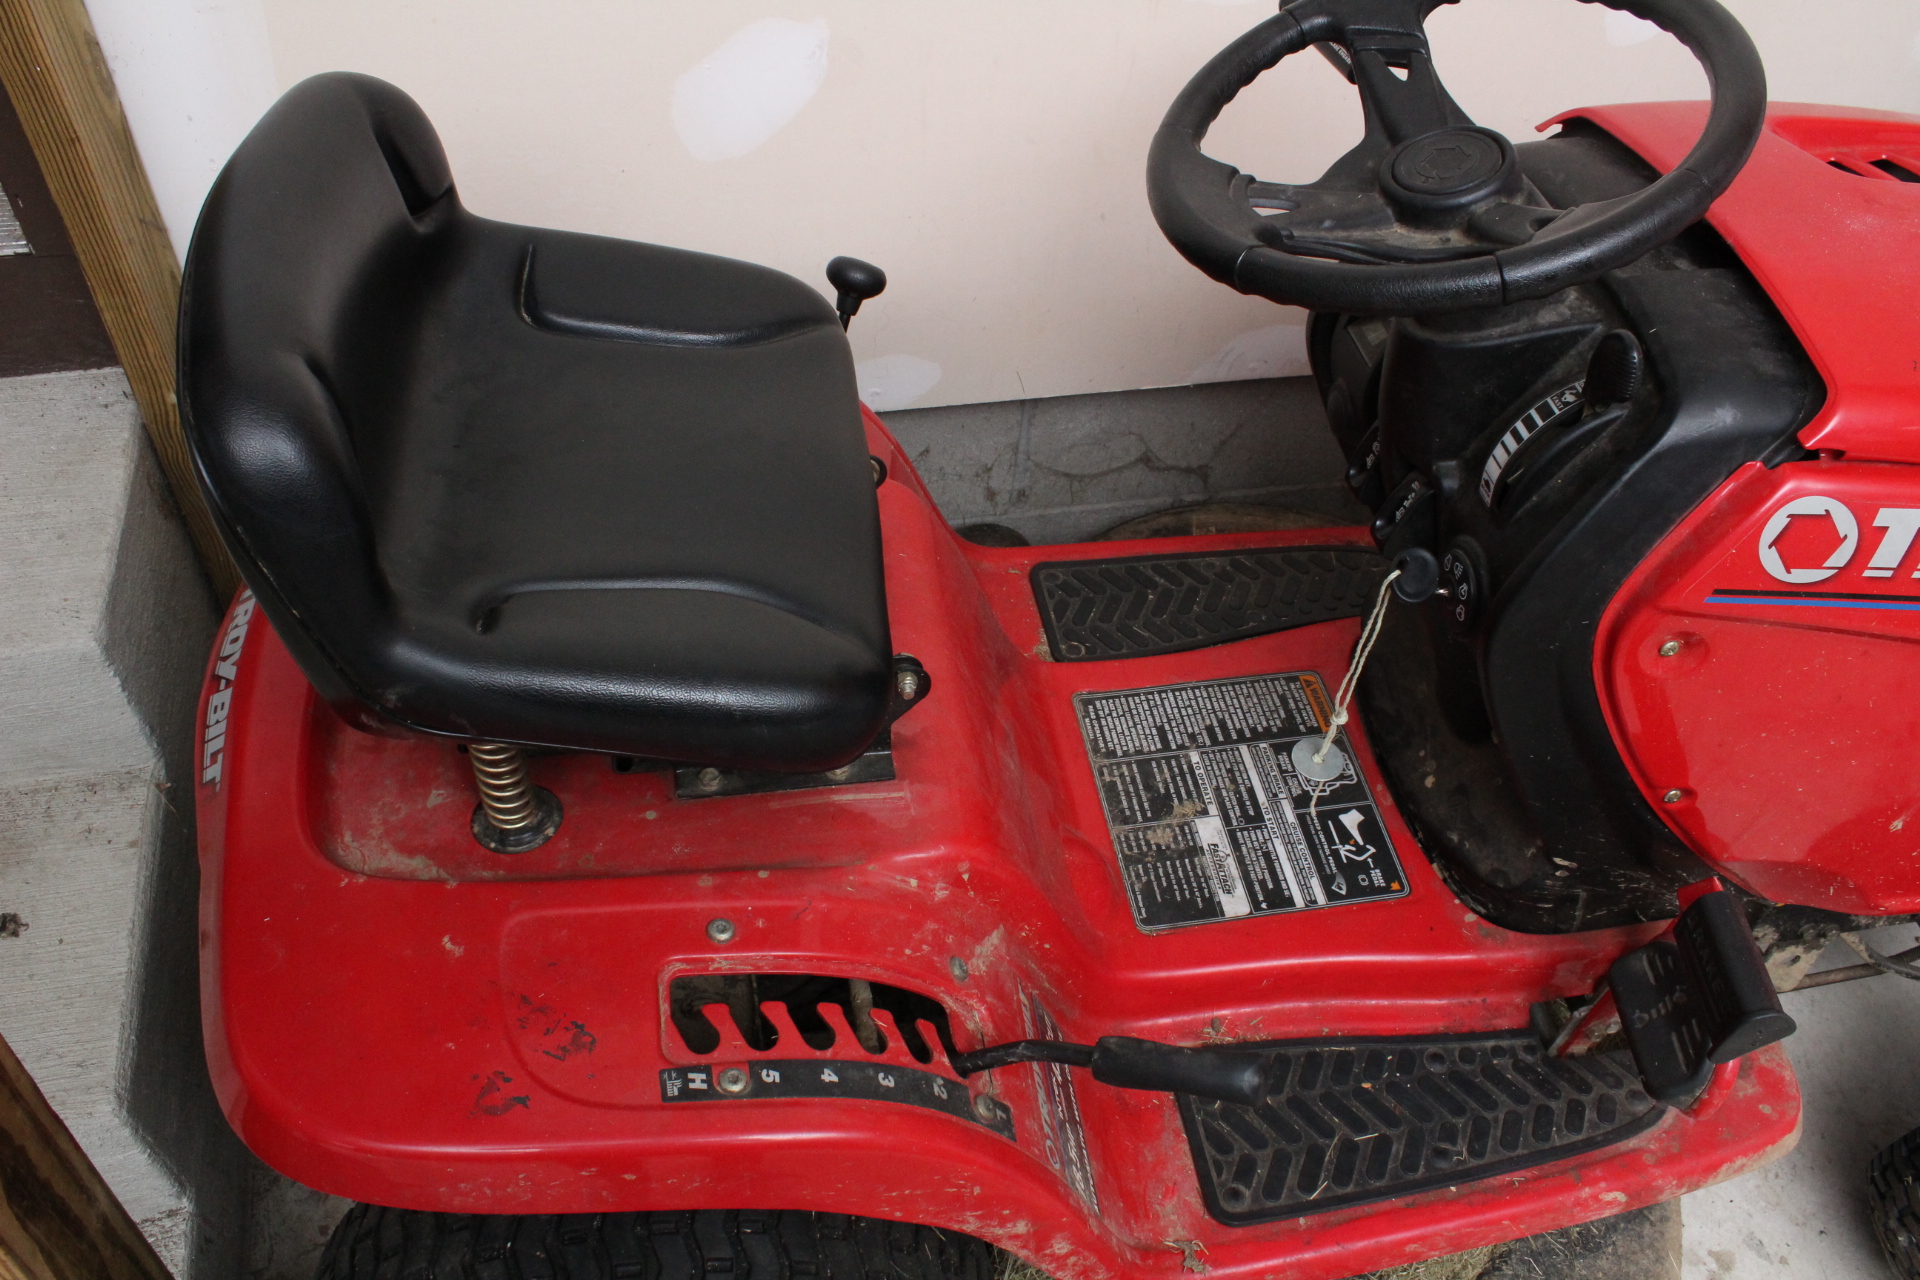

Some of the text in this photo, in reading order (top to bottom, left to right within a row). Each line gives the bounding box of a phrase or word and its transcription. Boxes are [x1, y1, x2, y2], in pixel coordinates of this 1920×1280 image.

[1552, 396, 1564, 409] FAST
[1862, 508, 1920, 578] T
[1289, 683, 1301, 700] INJURY
[1298, 689, 1309, 704] AVOID
[1088, 705, 1096, 719] READ
[1310, 688, 1333, 727] WARNING
[1193, 761, 1202, 771] TO
[1261, 747, 1276, 773] PARKING
[1272, 774, 1284, 795] BRAKE
[1277, 755, 1287, 770] BRAKE
[1281, 752, 1293, 772] PARKING
[1197, 773, 1214, 806] OPERATE
[1285, 776, 1298, 797] CONTROL
[1262, 806, 1270, 815] TO
[1266, 818, 1279, 840] START
[1289, 822, 1316, 880] CRUISE CONTROL
[1317, 831, 1331, 856] CONTROL
[1327, 856, 1338, 874] PEDAL
[1369, 870, 1381, 887] PEDAL
[1374, 869, 1386, 887] BRAKE
[1018, 977, 1055, 1140] TROYBILT
[687, 1072, 708, 1090] H
[761, 1068, 780, 1084] 5
[820, 1068, 839, 1083] 4
[878, 1072, 895, 1088] 3
[933, 1082, 948, 1100] 2
[995, 1108, 1007, 1120] L
